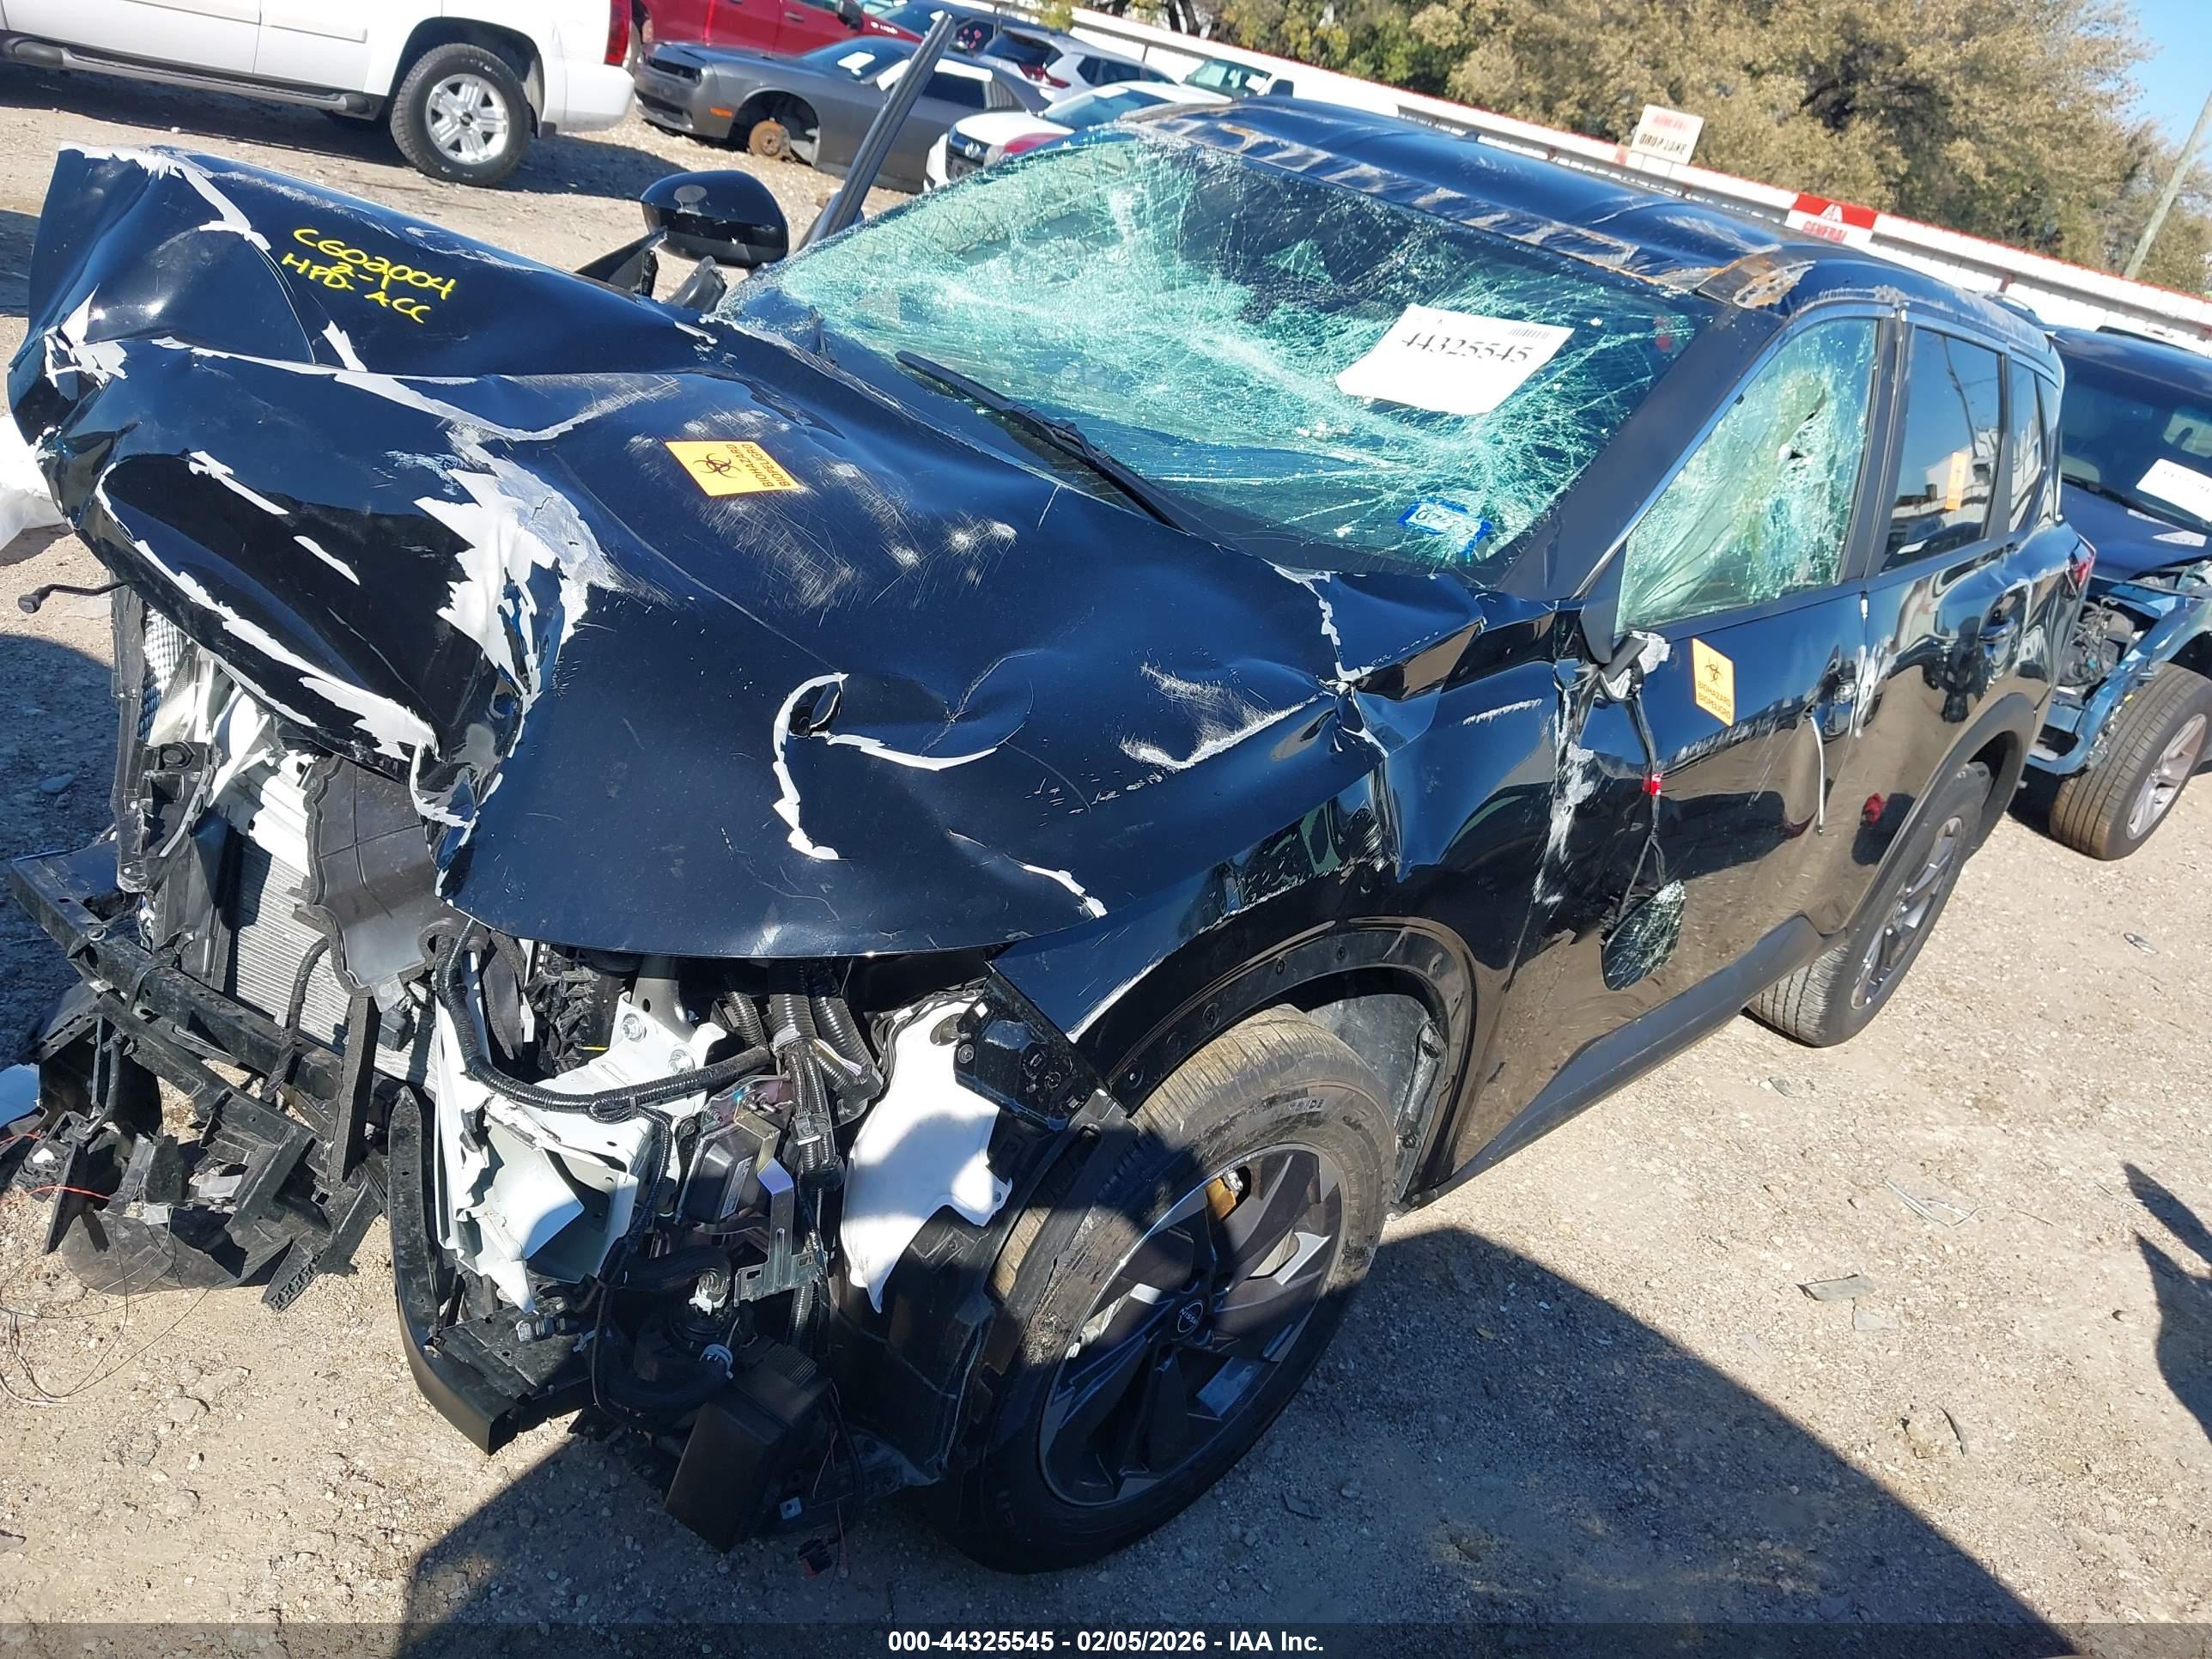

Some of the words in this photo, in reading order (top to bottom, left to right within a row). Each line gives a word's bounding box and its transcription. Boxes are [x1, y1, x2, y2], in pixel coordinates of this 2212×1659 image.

[1401, 331, 1534, 363] 44325545
[725, 443, 775, 488] BIOHAZARD
[741, 443, 792, 488] BIOPELIGRO
[1698, 680, 1732, 708] BIOHAZARD
[1698, 692, 1732, 720] BIOPELIGRO
